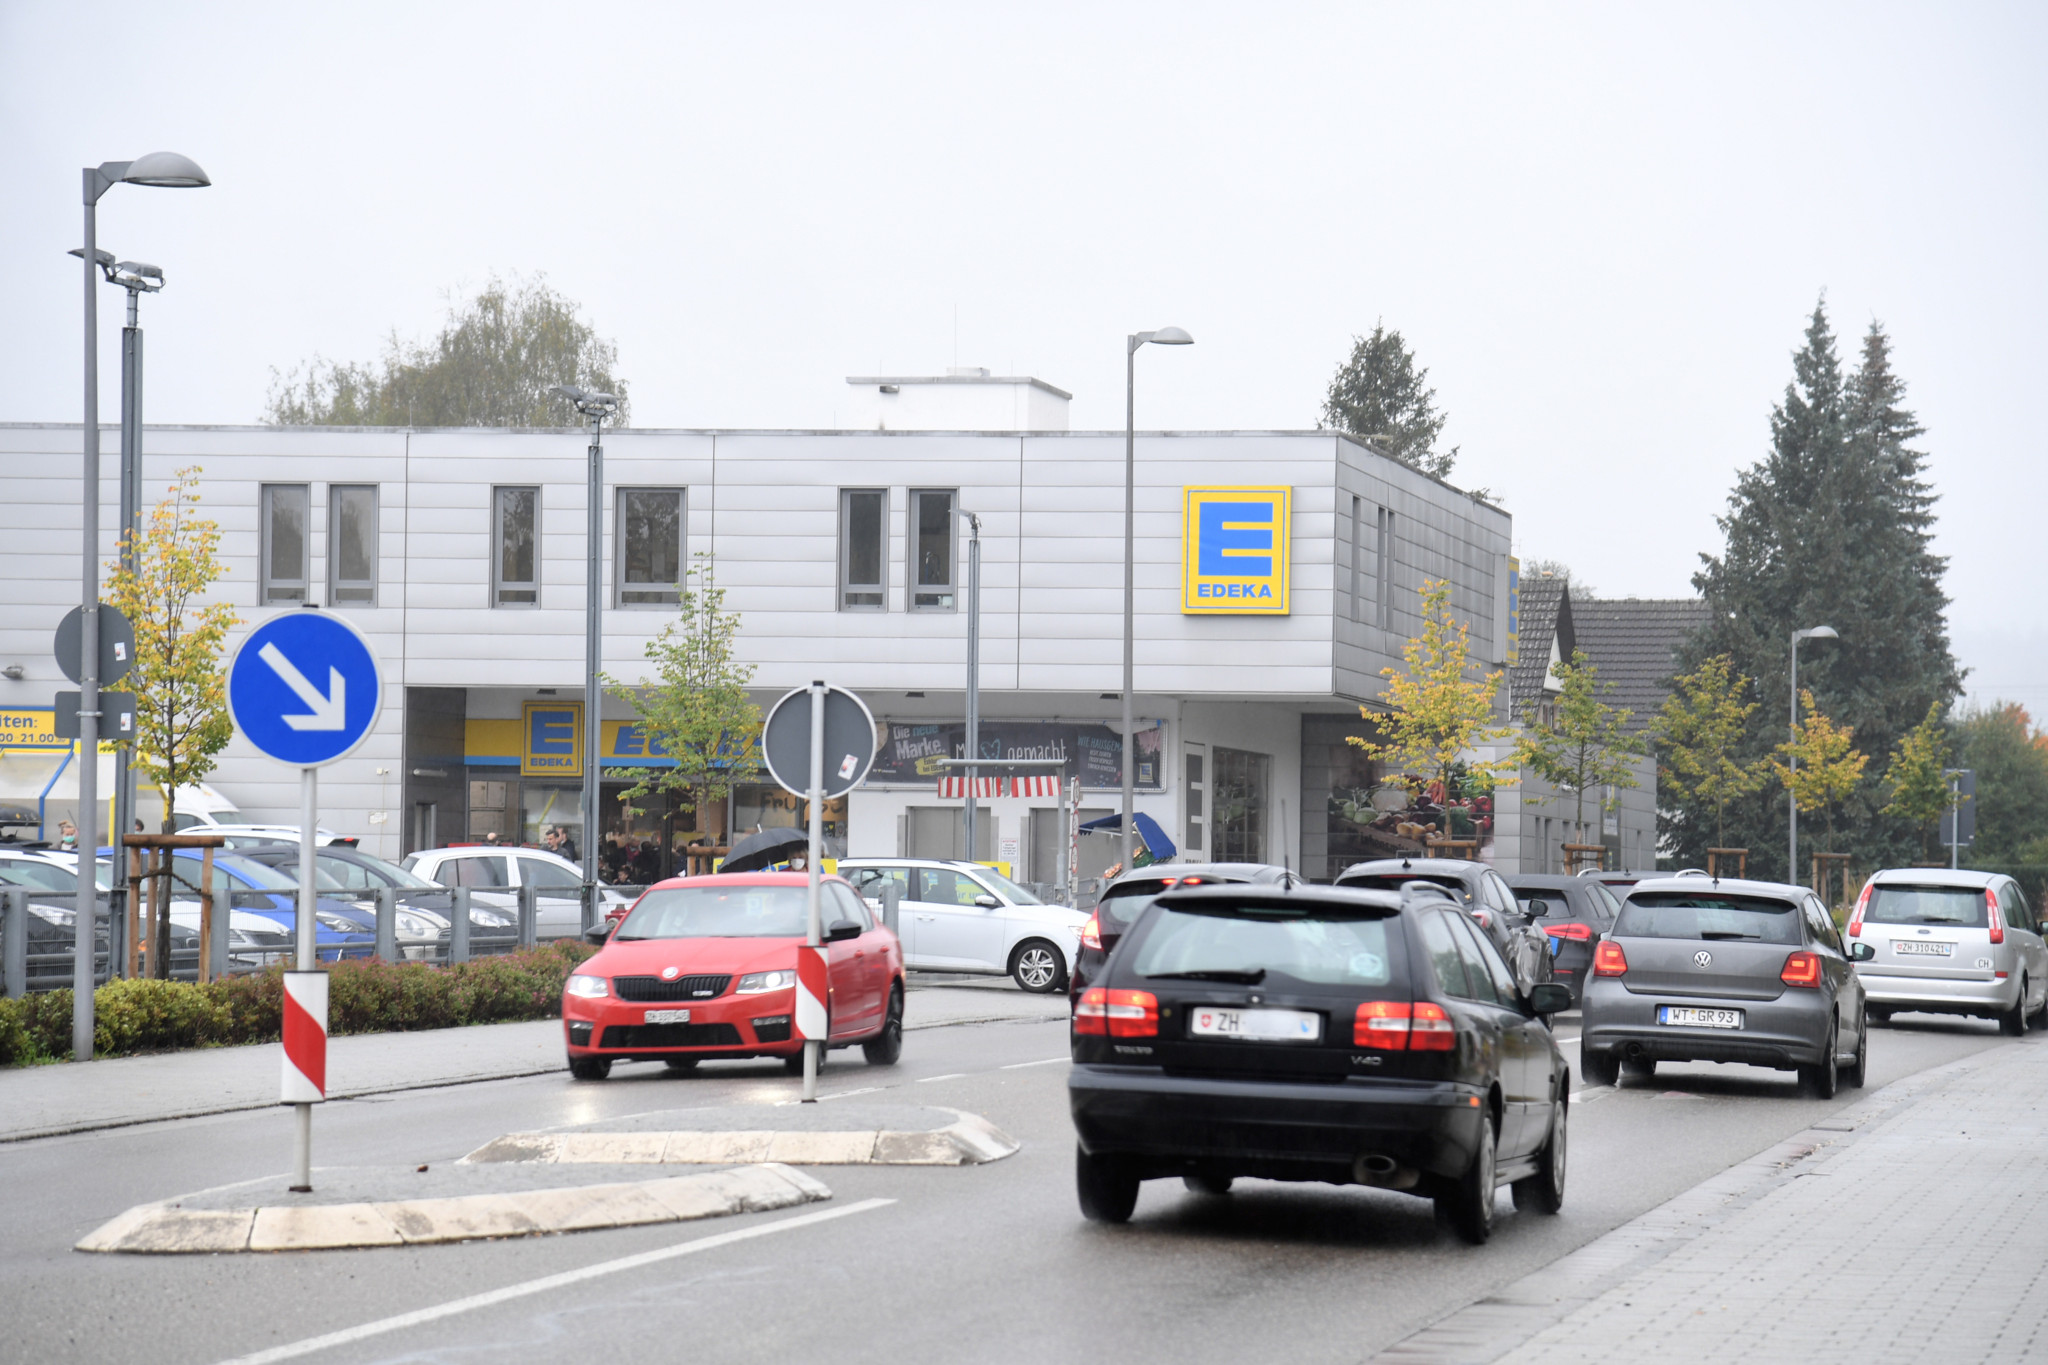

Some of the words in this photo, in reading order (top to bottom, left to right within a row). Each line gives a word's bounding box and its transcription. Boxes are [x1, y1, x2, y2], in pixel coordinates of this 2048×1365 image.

[1198, 502, 1273, 576] E
[1197, 583, 1273, 598] EDEKA
[20, 733, 54, 743] 21.00
[531, 711, 574, 755] E
[893, 726, 910, 740] Die
[912, 725, 938, 736] neue
[896, 738, 946, 760] Marke.
[1007, 738, 1072, 770] gemacht.
[530, 757, 573, 767] EDEKA
[1978, 959, 1989, 968] CH
[1217, 1012, 1239, 1032] ZH
[1672, 1009, 1689, 1021] WT
